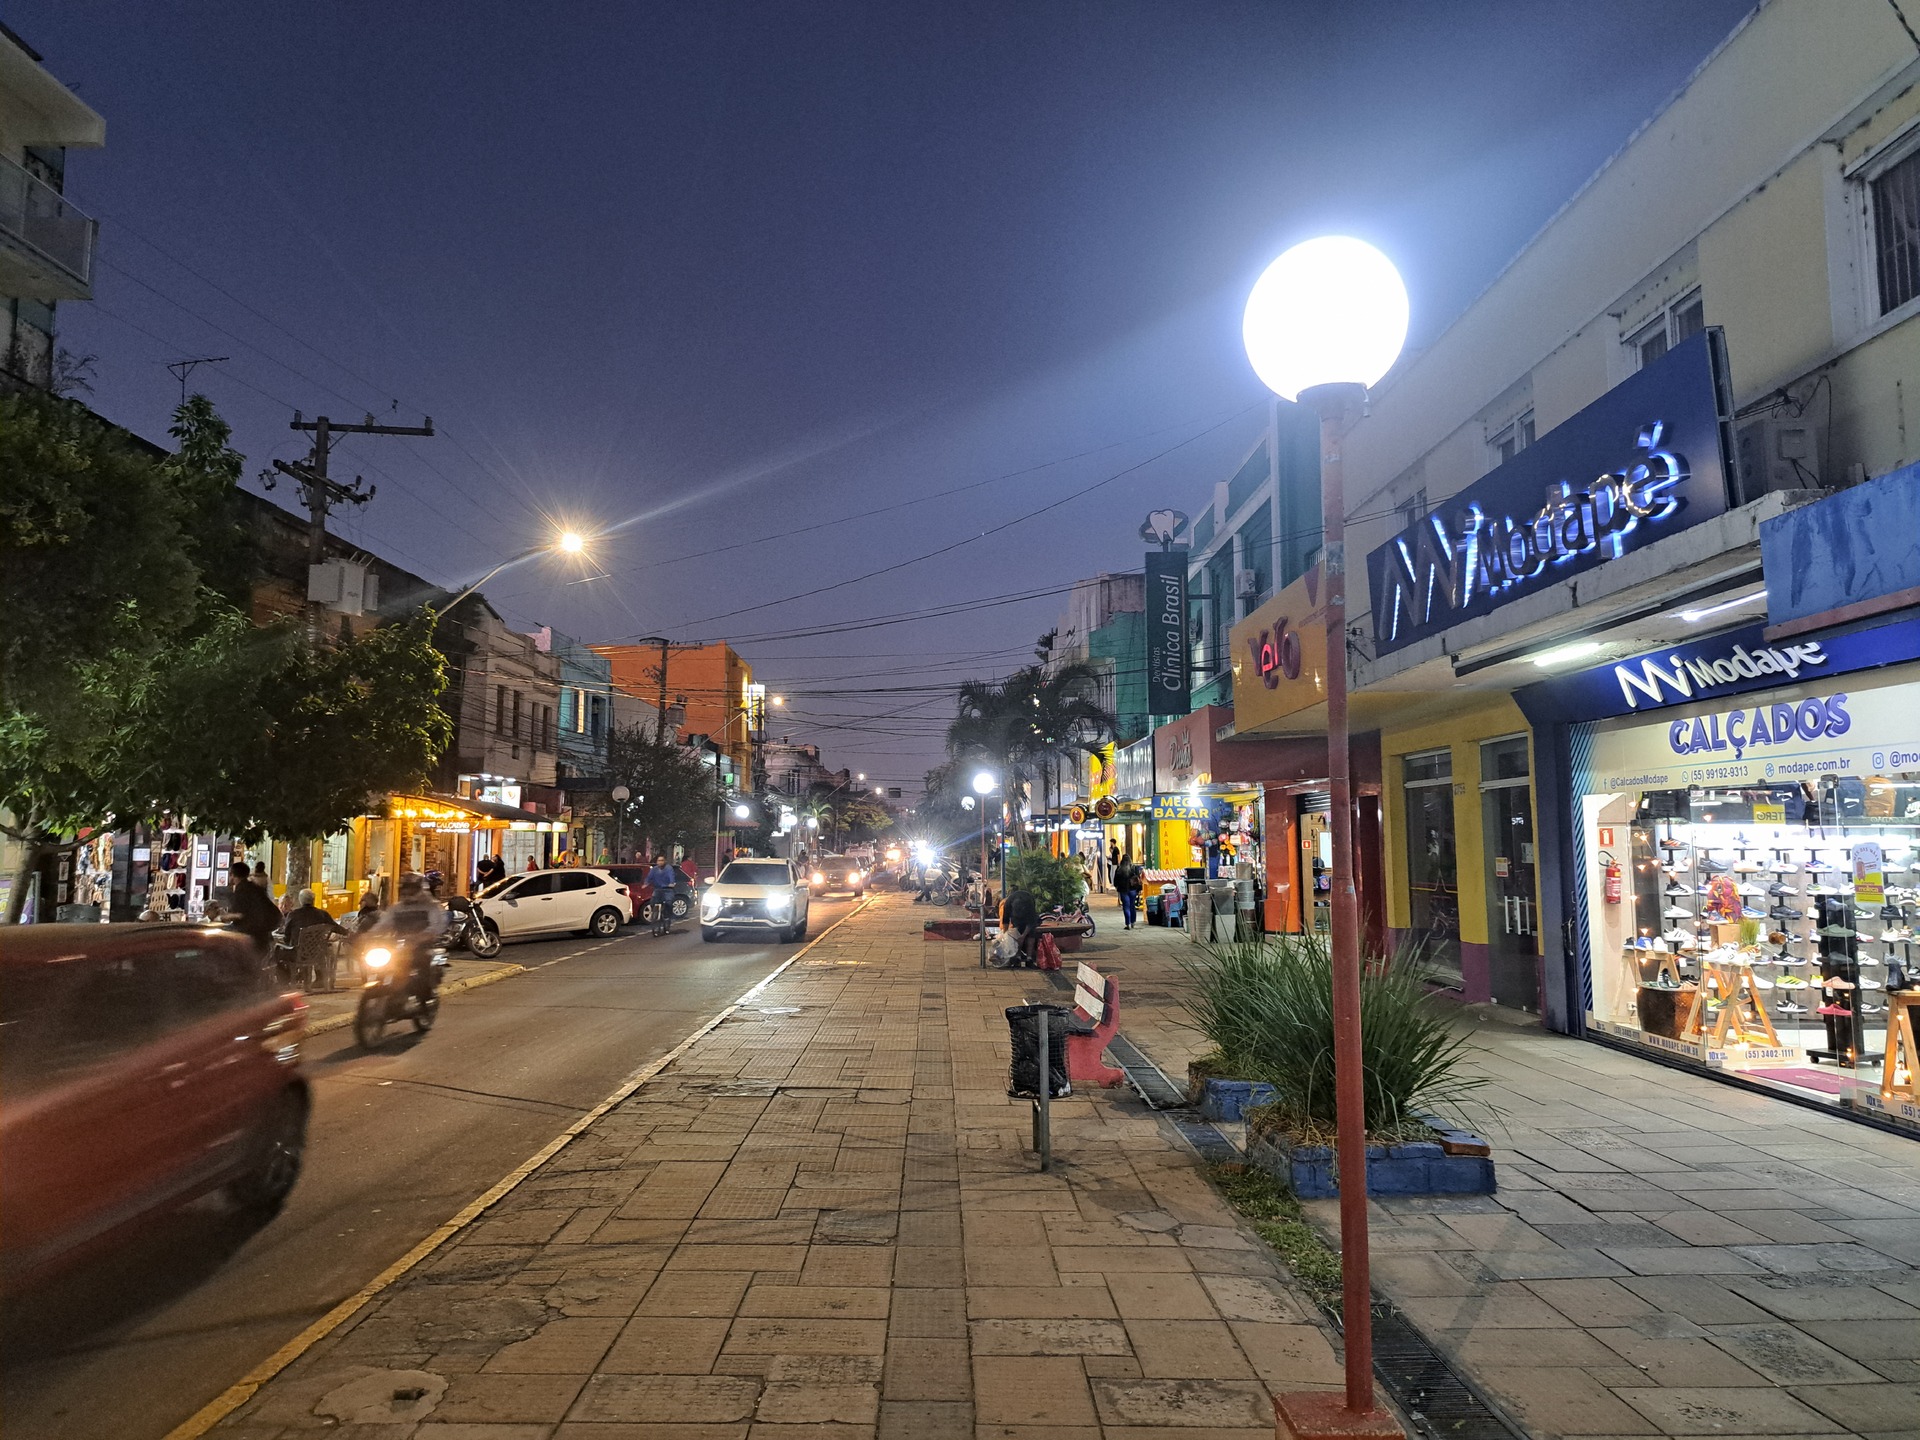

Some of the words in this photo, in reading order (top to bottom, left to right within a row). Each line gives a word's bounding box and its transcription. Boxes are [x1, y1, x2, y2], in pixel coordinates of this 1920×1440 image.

[1160, 574, 1180, 626] Brasil
[1669, 693, 1852, 760] CALÇADOS
[1778, 757, 1851, 774] modape.com.br
[1889, 751, 1920, 768] @mo
[1610, 774, 1669, 789] @CalcadosModape
[1691, 770, 1705, 782] (55)
[1706, 765, 1749, 780] 99192-9313
[1154, 808, 1209, 818] BAZAR
[1745, 1050, 1759, 1059] (55)
[1762, 1049, 1794, 1058] 3402-1111
[1901, 1104, 1916, 1118] (55)
